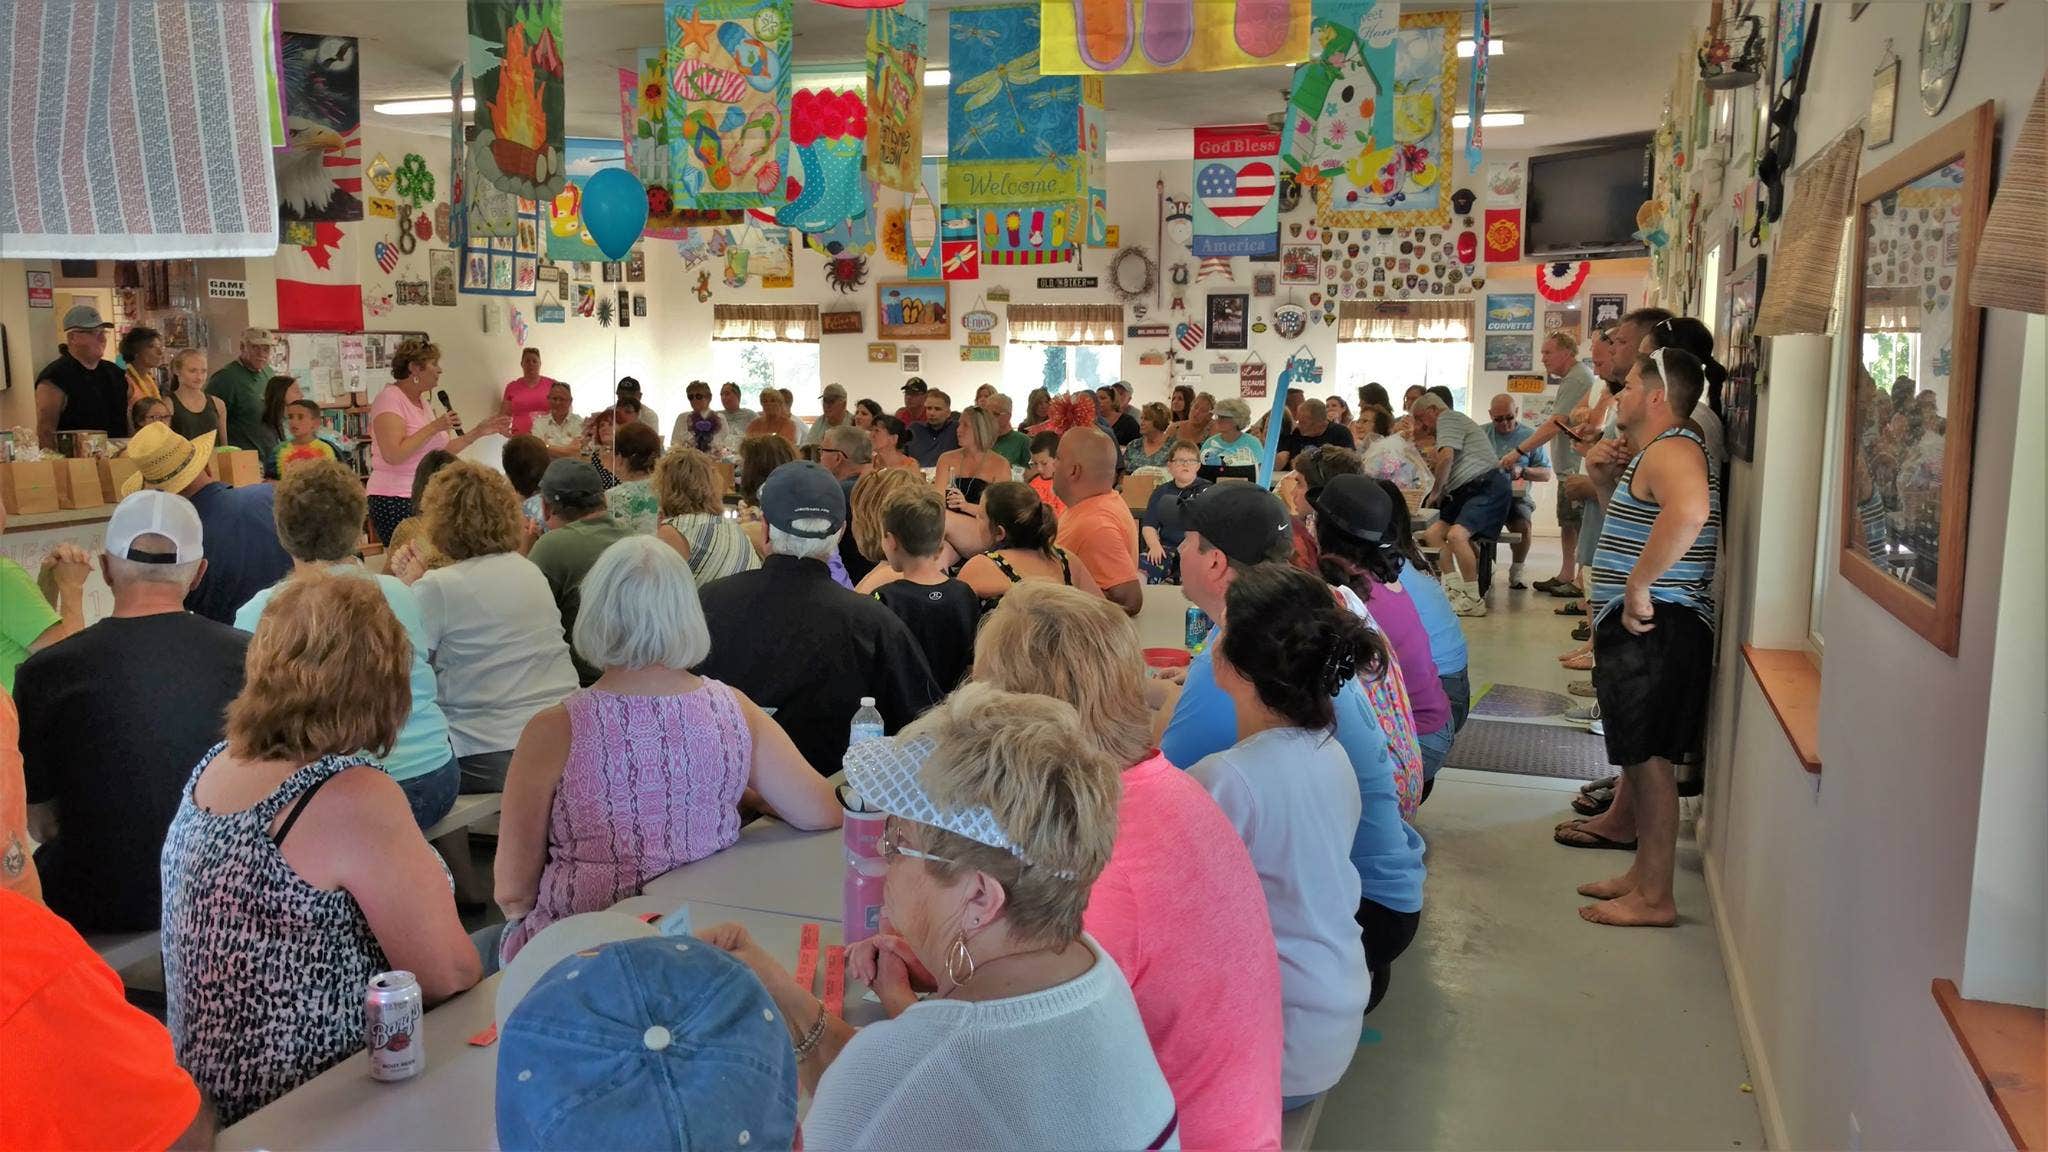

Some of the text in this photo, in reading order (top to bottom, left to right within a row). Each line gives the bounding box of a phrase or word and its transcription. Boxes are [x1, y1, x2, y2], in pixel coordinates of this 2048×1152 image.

[1200, 138, 1276, 154] God Bless
[962, 171, 1057, 196] Welcome
[1203, 238, 1266, 252] America
[209, 280, 246, 289] GAME
[210, 289, 246, 297] ROOM
[1487, 321, 1532, 330] CORVETTE
